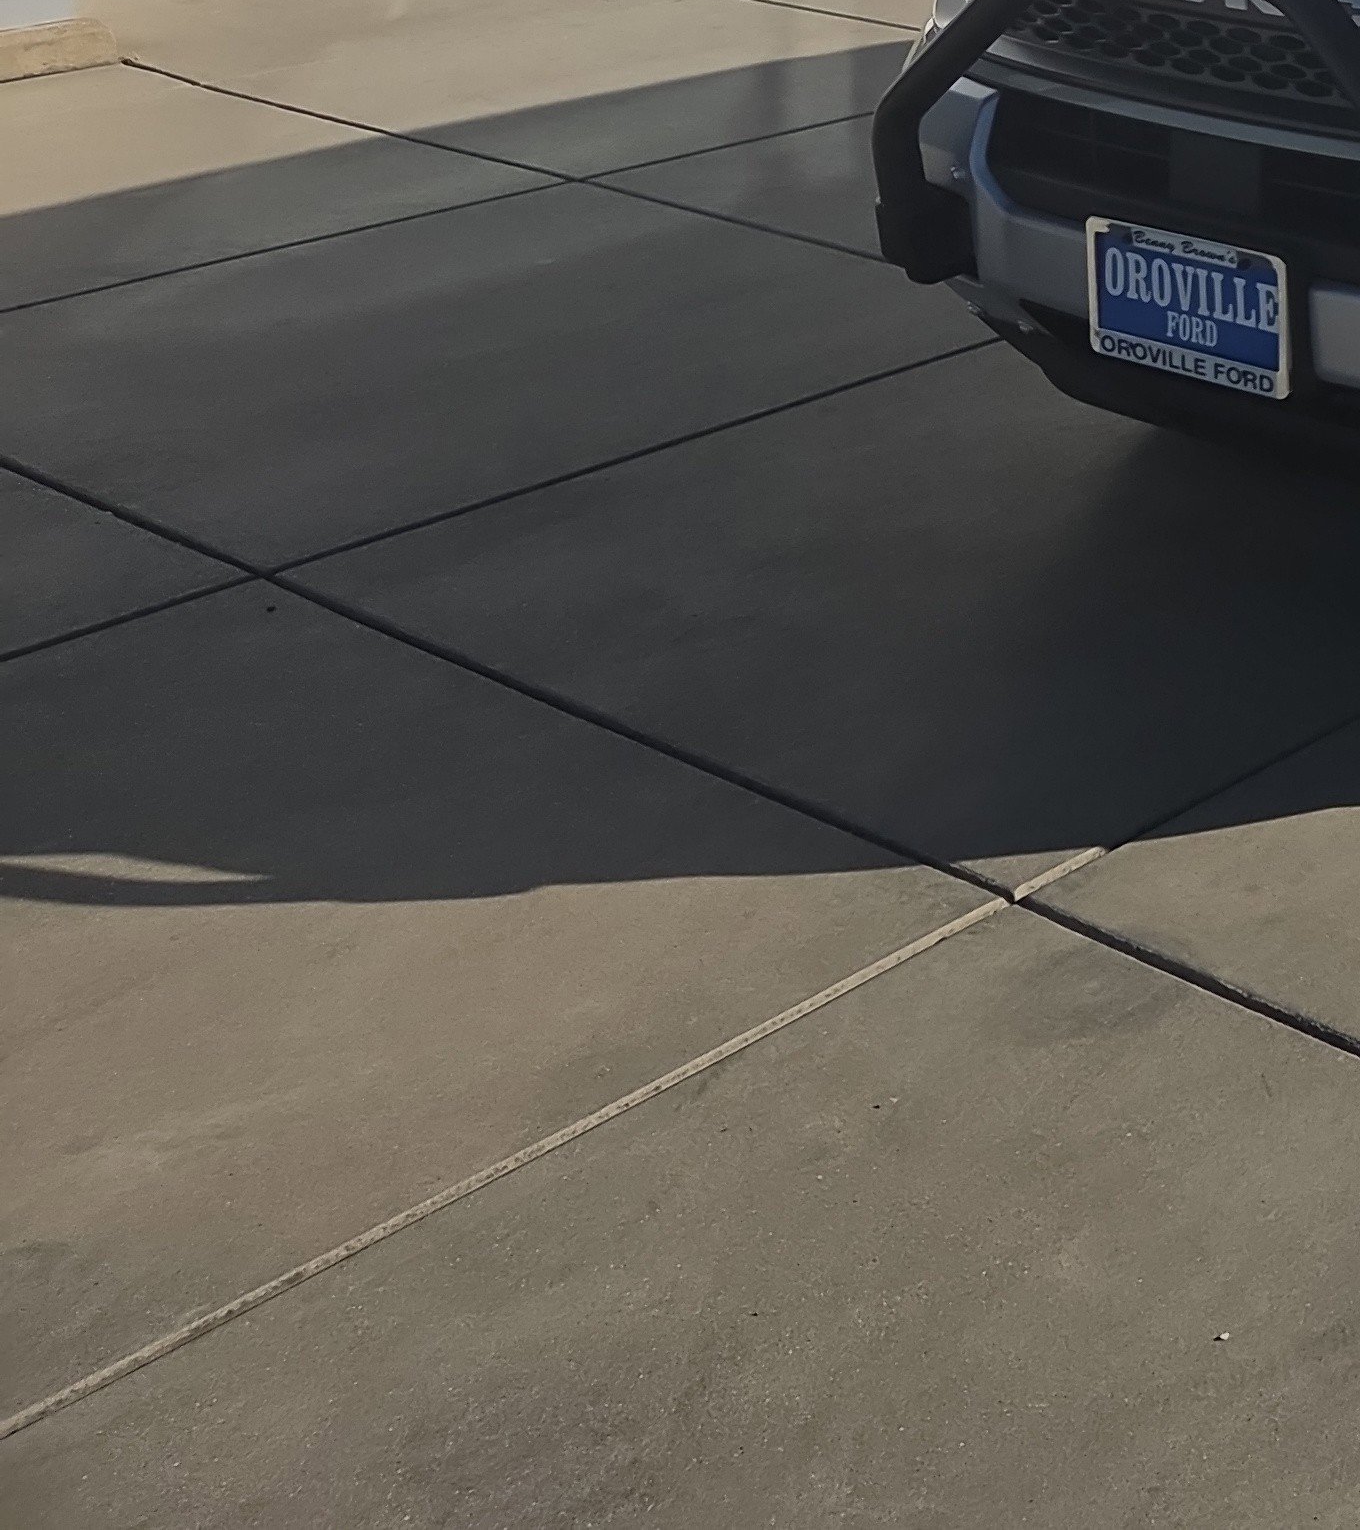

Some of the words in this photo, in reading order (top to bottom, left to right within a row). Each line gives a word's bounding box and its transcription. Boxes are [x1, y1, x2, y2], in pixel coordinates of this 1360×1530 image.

[1132, 230, 1175, 253] Benny
[1180, 240, 1237, 265] Brown's
[1104, 247, 1279, 334] OROVILLE
[1166, 311, 1218, 348] FORD
[1101, 334, 1207, 377] OROVILLE
[1213, 362, 1275, 394] FORD
